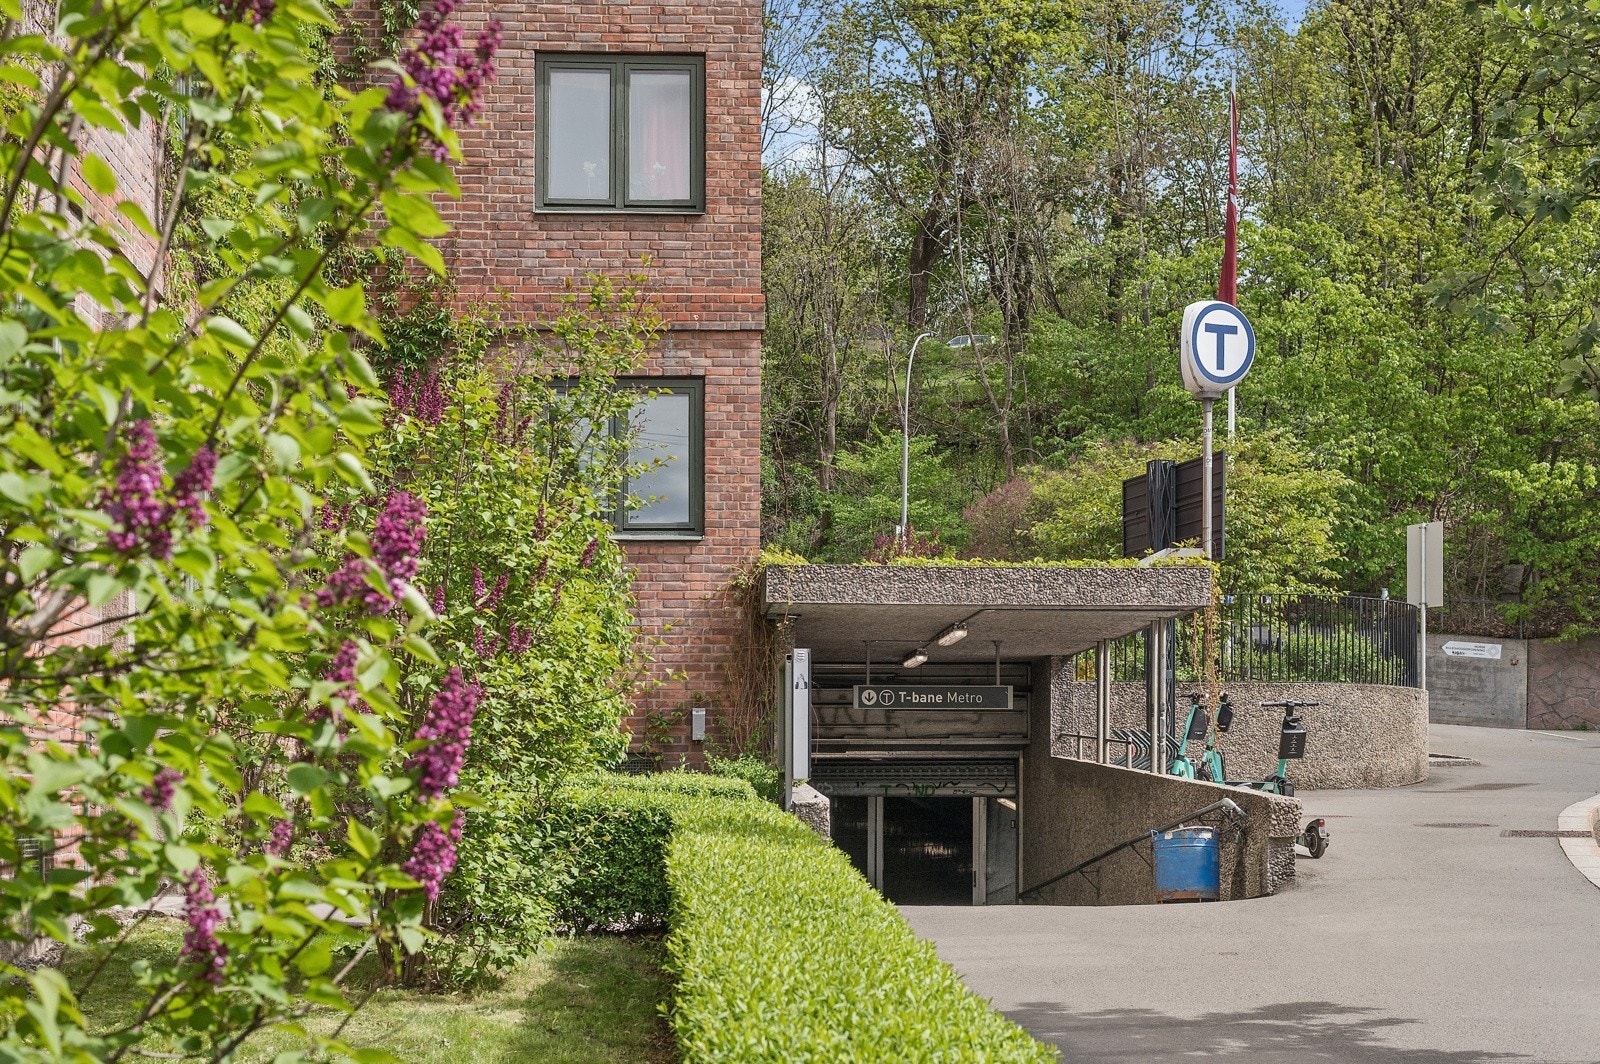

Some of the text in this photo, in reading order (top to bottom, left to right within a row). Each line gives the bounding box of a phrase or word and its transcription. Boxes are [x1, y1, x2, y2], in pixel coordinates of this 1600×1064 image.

[1204, 322, 1238, 371] T
[898, 691, 943, 703] T-bane
[947, 691, 983, 703] Metro
